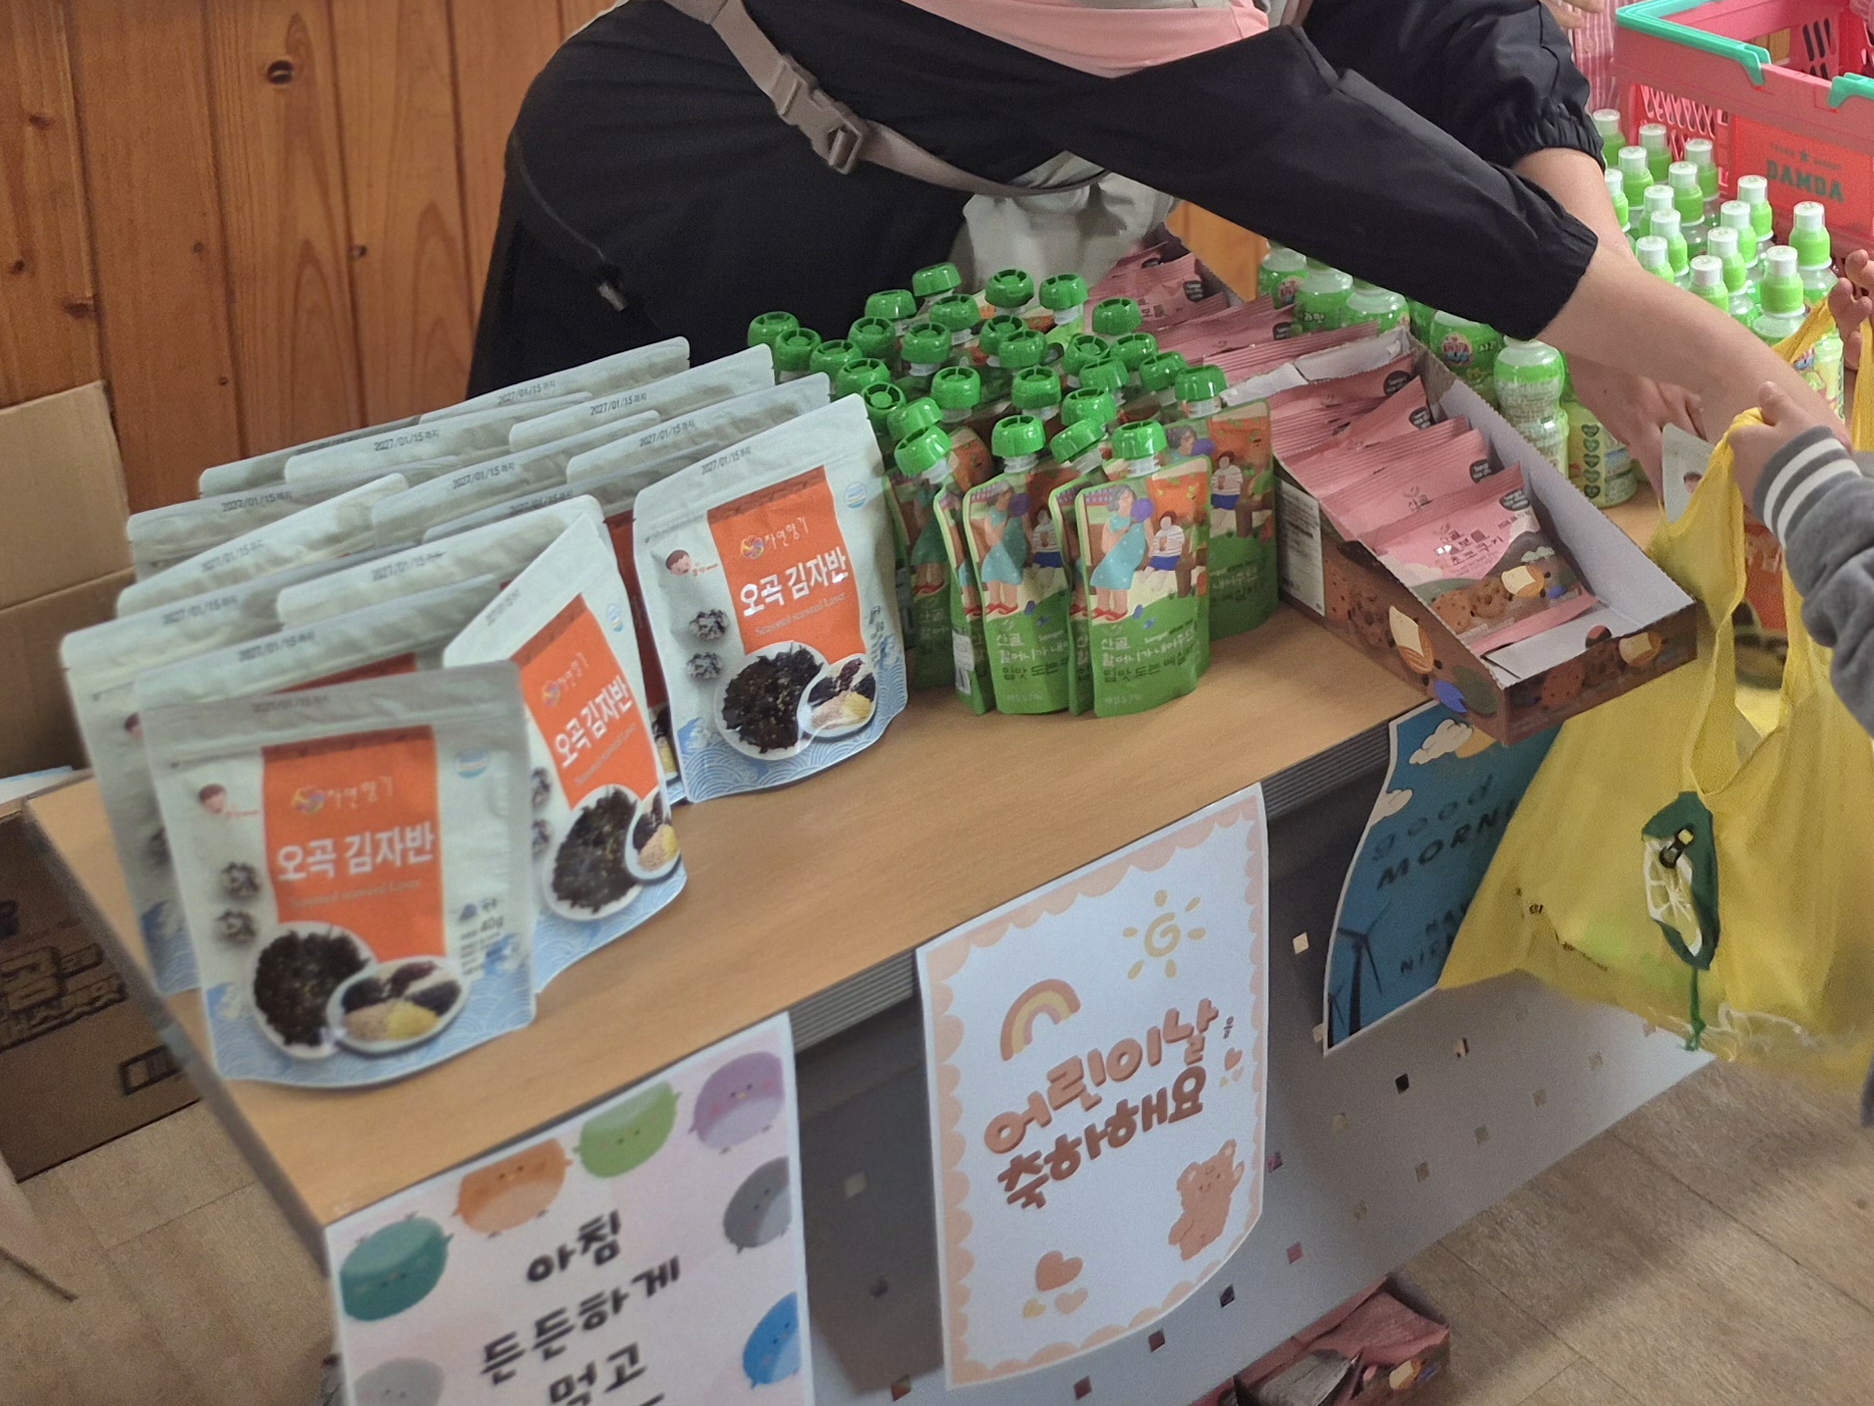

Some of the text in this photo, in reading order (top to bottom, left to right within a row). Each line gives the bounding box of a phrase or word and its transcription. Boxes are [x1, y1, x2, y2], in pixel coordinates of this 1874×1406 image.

[739, 546, 849, 618] 오곡 김자반
[555, 716, 593, 769] 오곡
[580, 674, 634, 740] 김자반
[278, 820, 435, 882] 오곡 김자반
[983, 996, 1220, 1154] 어린이날
[997, 1065, 1207, 1210] 축하해요
[526, 1208, 622, 1283] 아침
[481, 1254, 681, 1387] 든든하게
